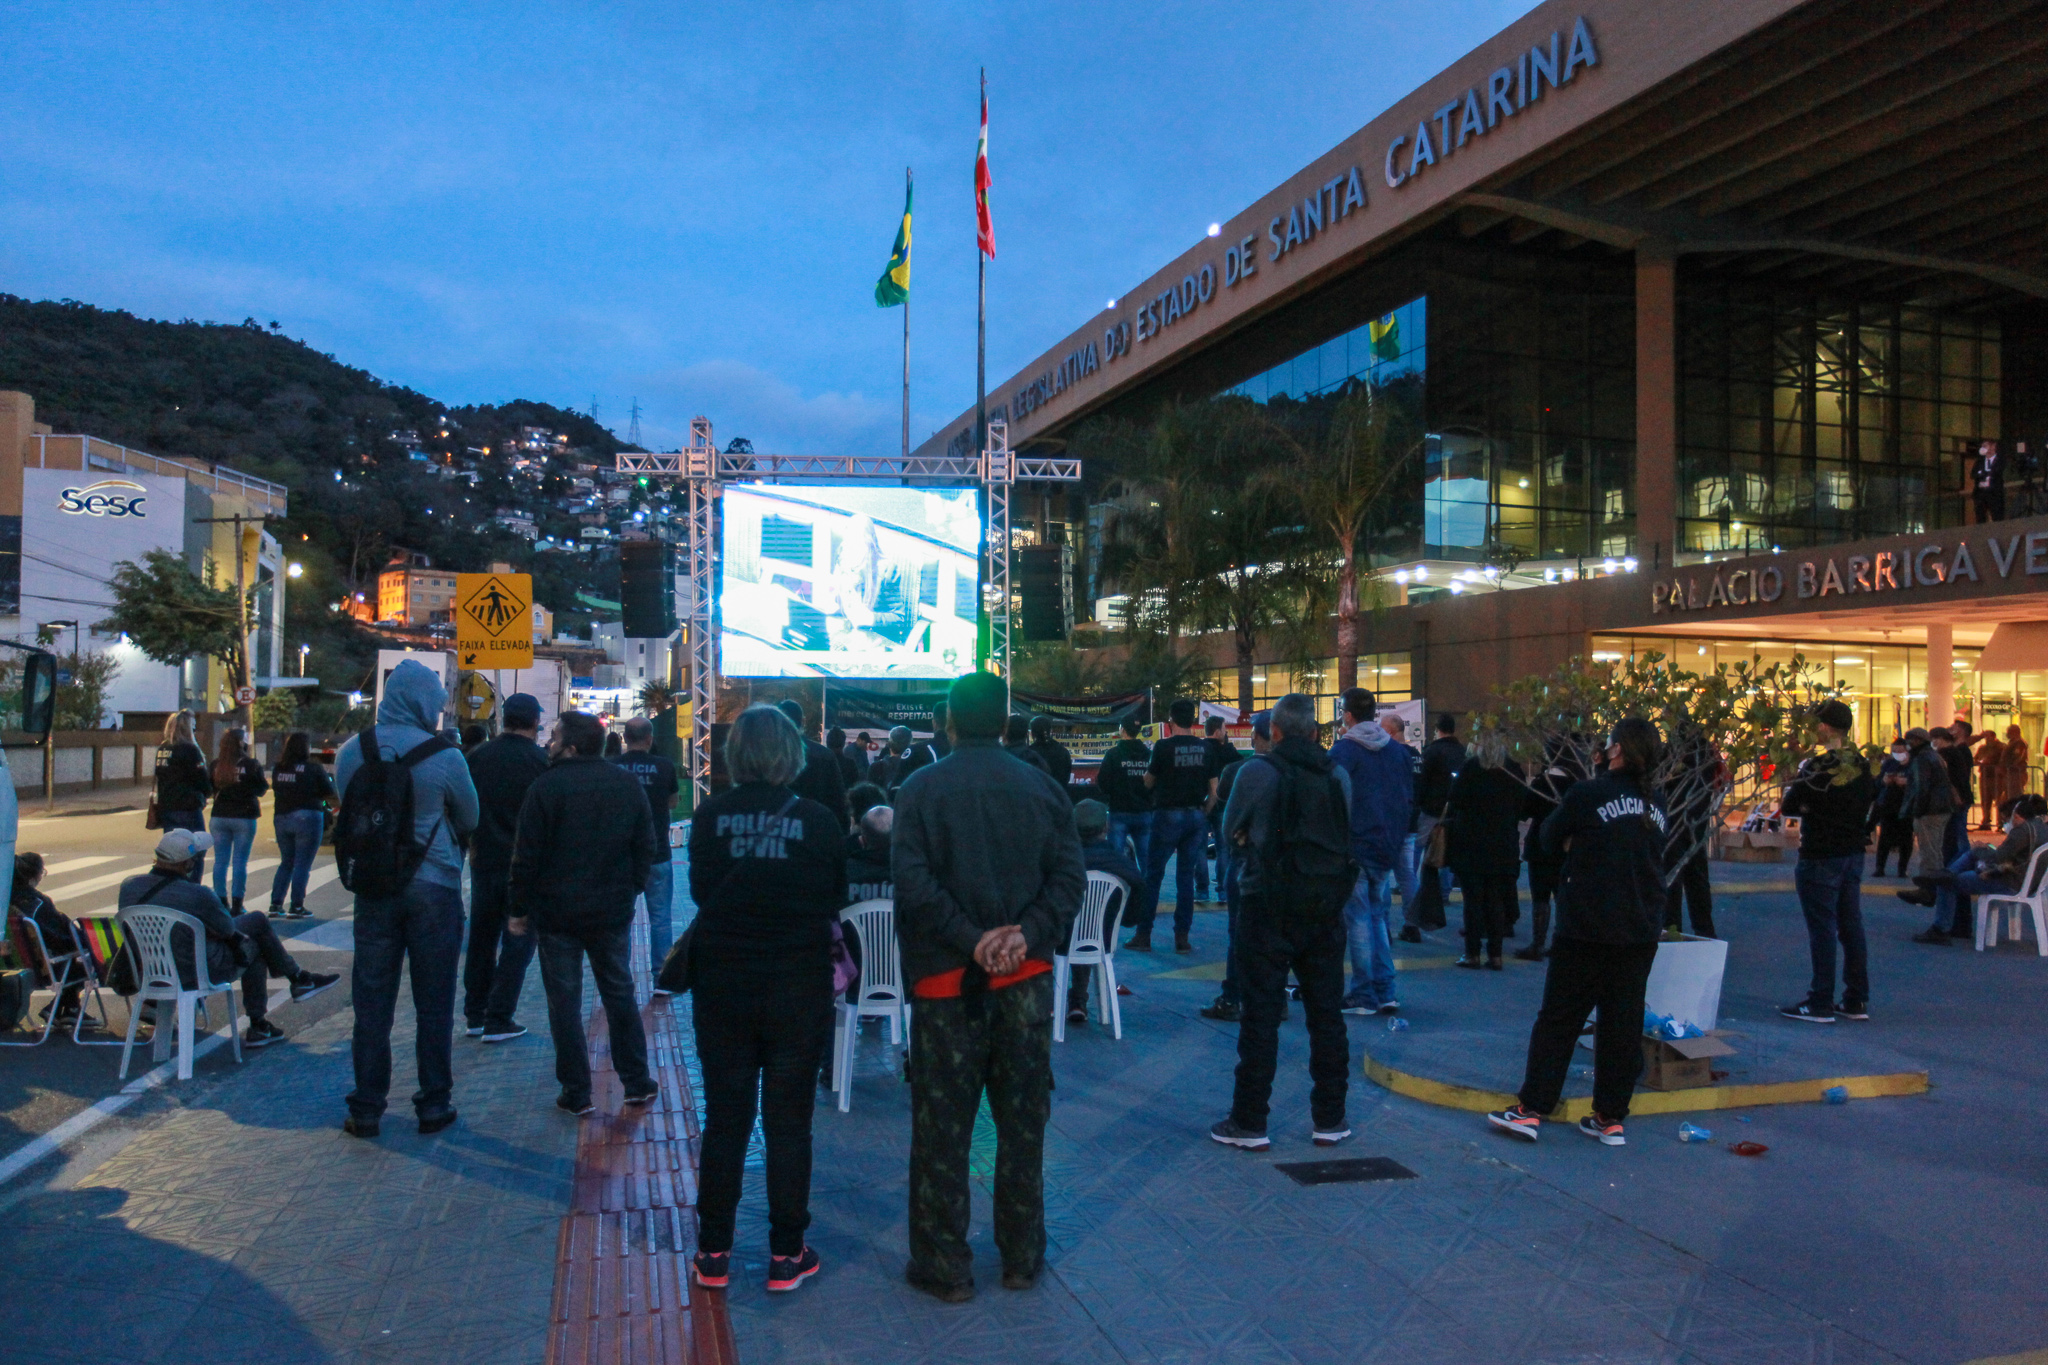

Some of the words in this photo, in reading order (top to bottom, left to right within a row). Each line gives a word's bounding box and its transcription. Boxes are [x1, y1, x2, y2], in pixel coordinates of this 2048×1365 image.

[1104, 322, 1130, 362] DO
[1137, 264, 1214, 342] ESTADO
[1225, 234, 1255, 288] DE
[1268, 167, 1365, 262] SANTA
[1385, 16, 1597, 188] CATARINA
[58, 485, 147, 518] Sesc
[1652, 566, 1783, 613] PALÁCIO
[1797, 542, 1978, 599] BARRIGA
[460, 640, 485, 650] FAIXA
[490, 640, 530, 652] ELEVADA
[888, 712, 934, 720] RESPEITAD
[1174, 755, 1205, 767] PENAL
[277, 773, 297, 783] CIVIL
[1127, 769, 1147, 777] CIVIL
[1597, 794, 1645, 823] POLÍCIA
[716, 810, 804, 840] POLÍCIA
[730, 836, 788, 859] CIVIL
